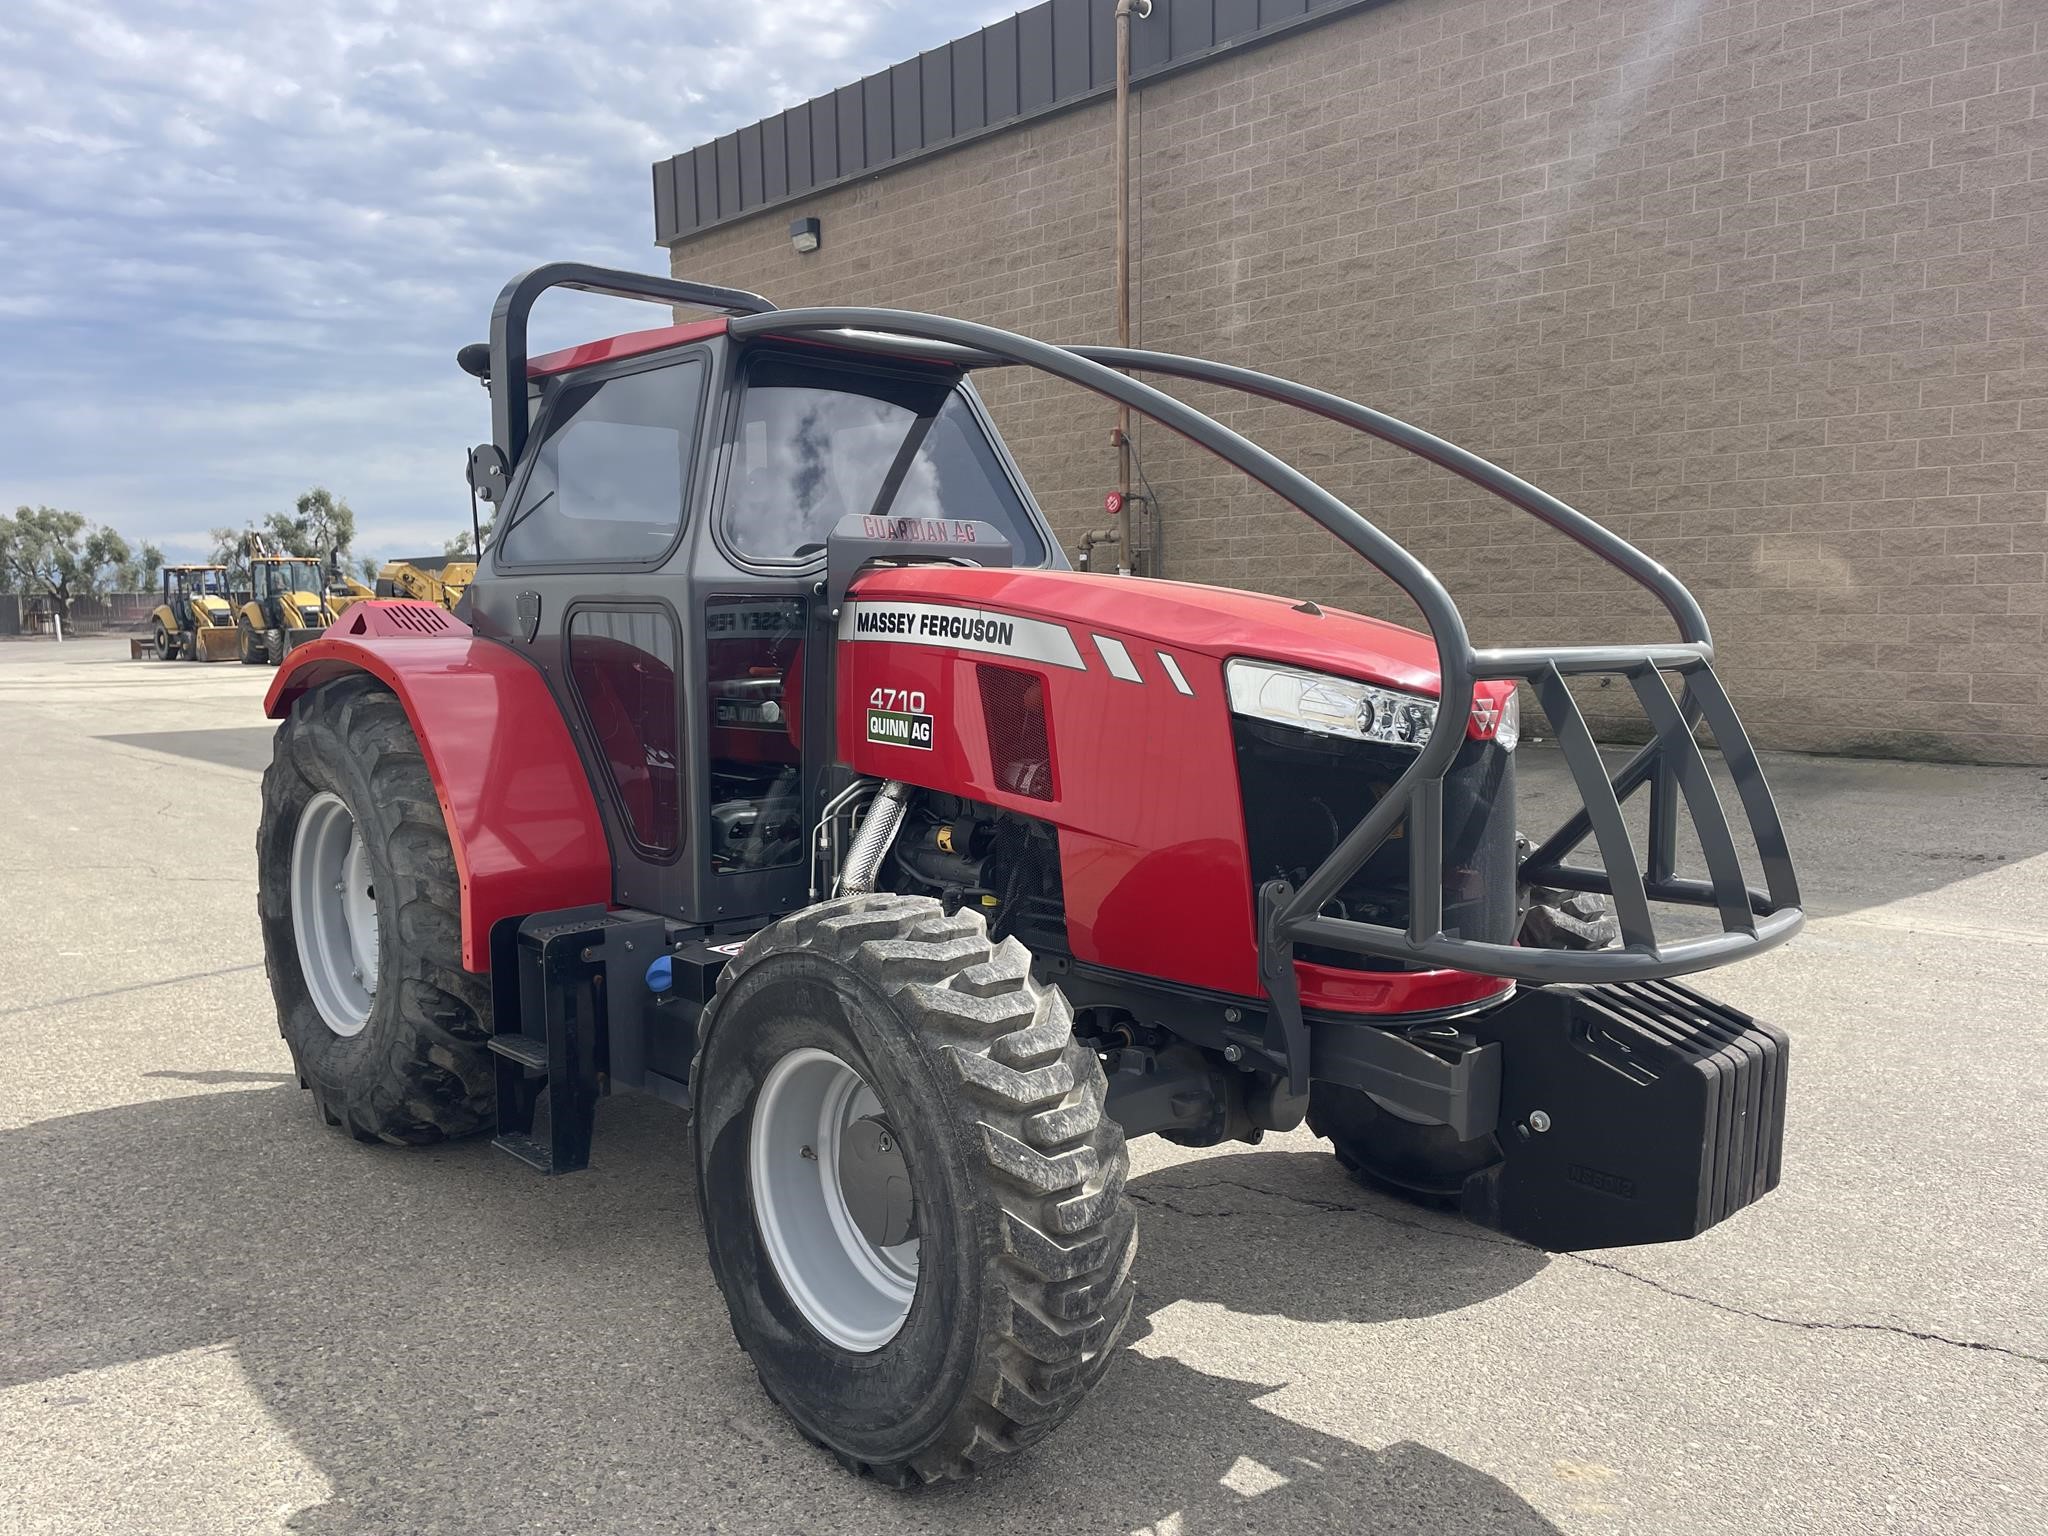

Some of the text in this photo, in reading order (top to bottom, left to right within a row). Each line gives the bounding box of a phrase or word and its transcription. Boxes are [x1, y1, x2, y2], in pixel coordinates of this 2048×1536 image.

[863, 516, 976, 543] GUARDIAN AG
[857, 612, 1014, 646] MASSEY FERGUSON
[870, 687, 925, 713] 4710
[870, 716, 930, 741] QUINN AG
